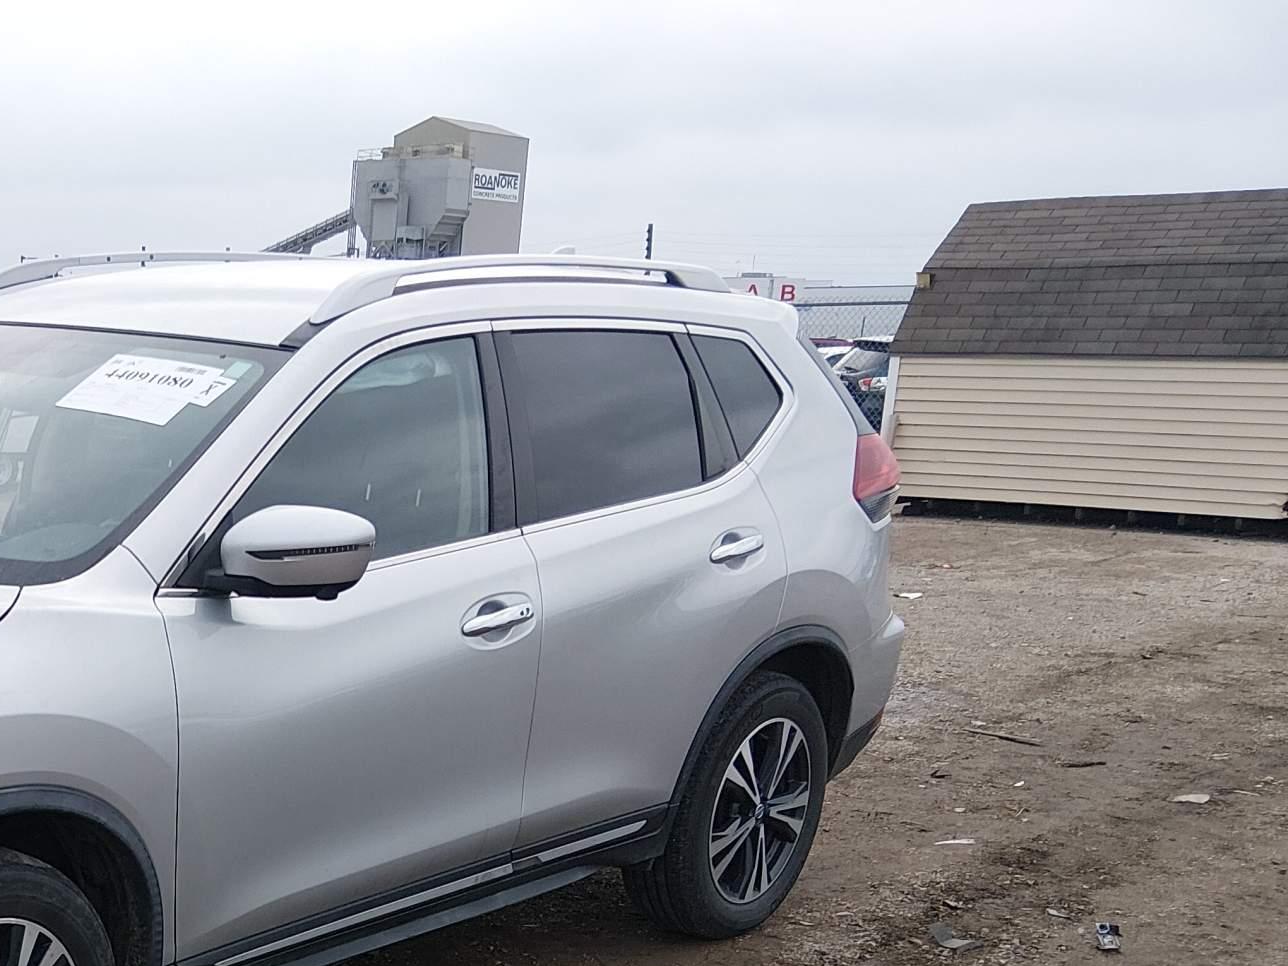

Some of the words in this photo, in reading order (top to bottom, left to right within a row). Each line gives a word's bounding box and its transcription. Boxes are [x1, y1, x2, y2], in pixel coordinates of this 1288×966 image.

[474, 174, 519, 190] ROANOKE
[780, 284, 796, 302] B
[104, 368, 194, 389] 44091080
